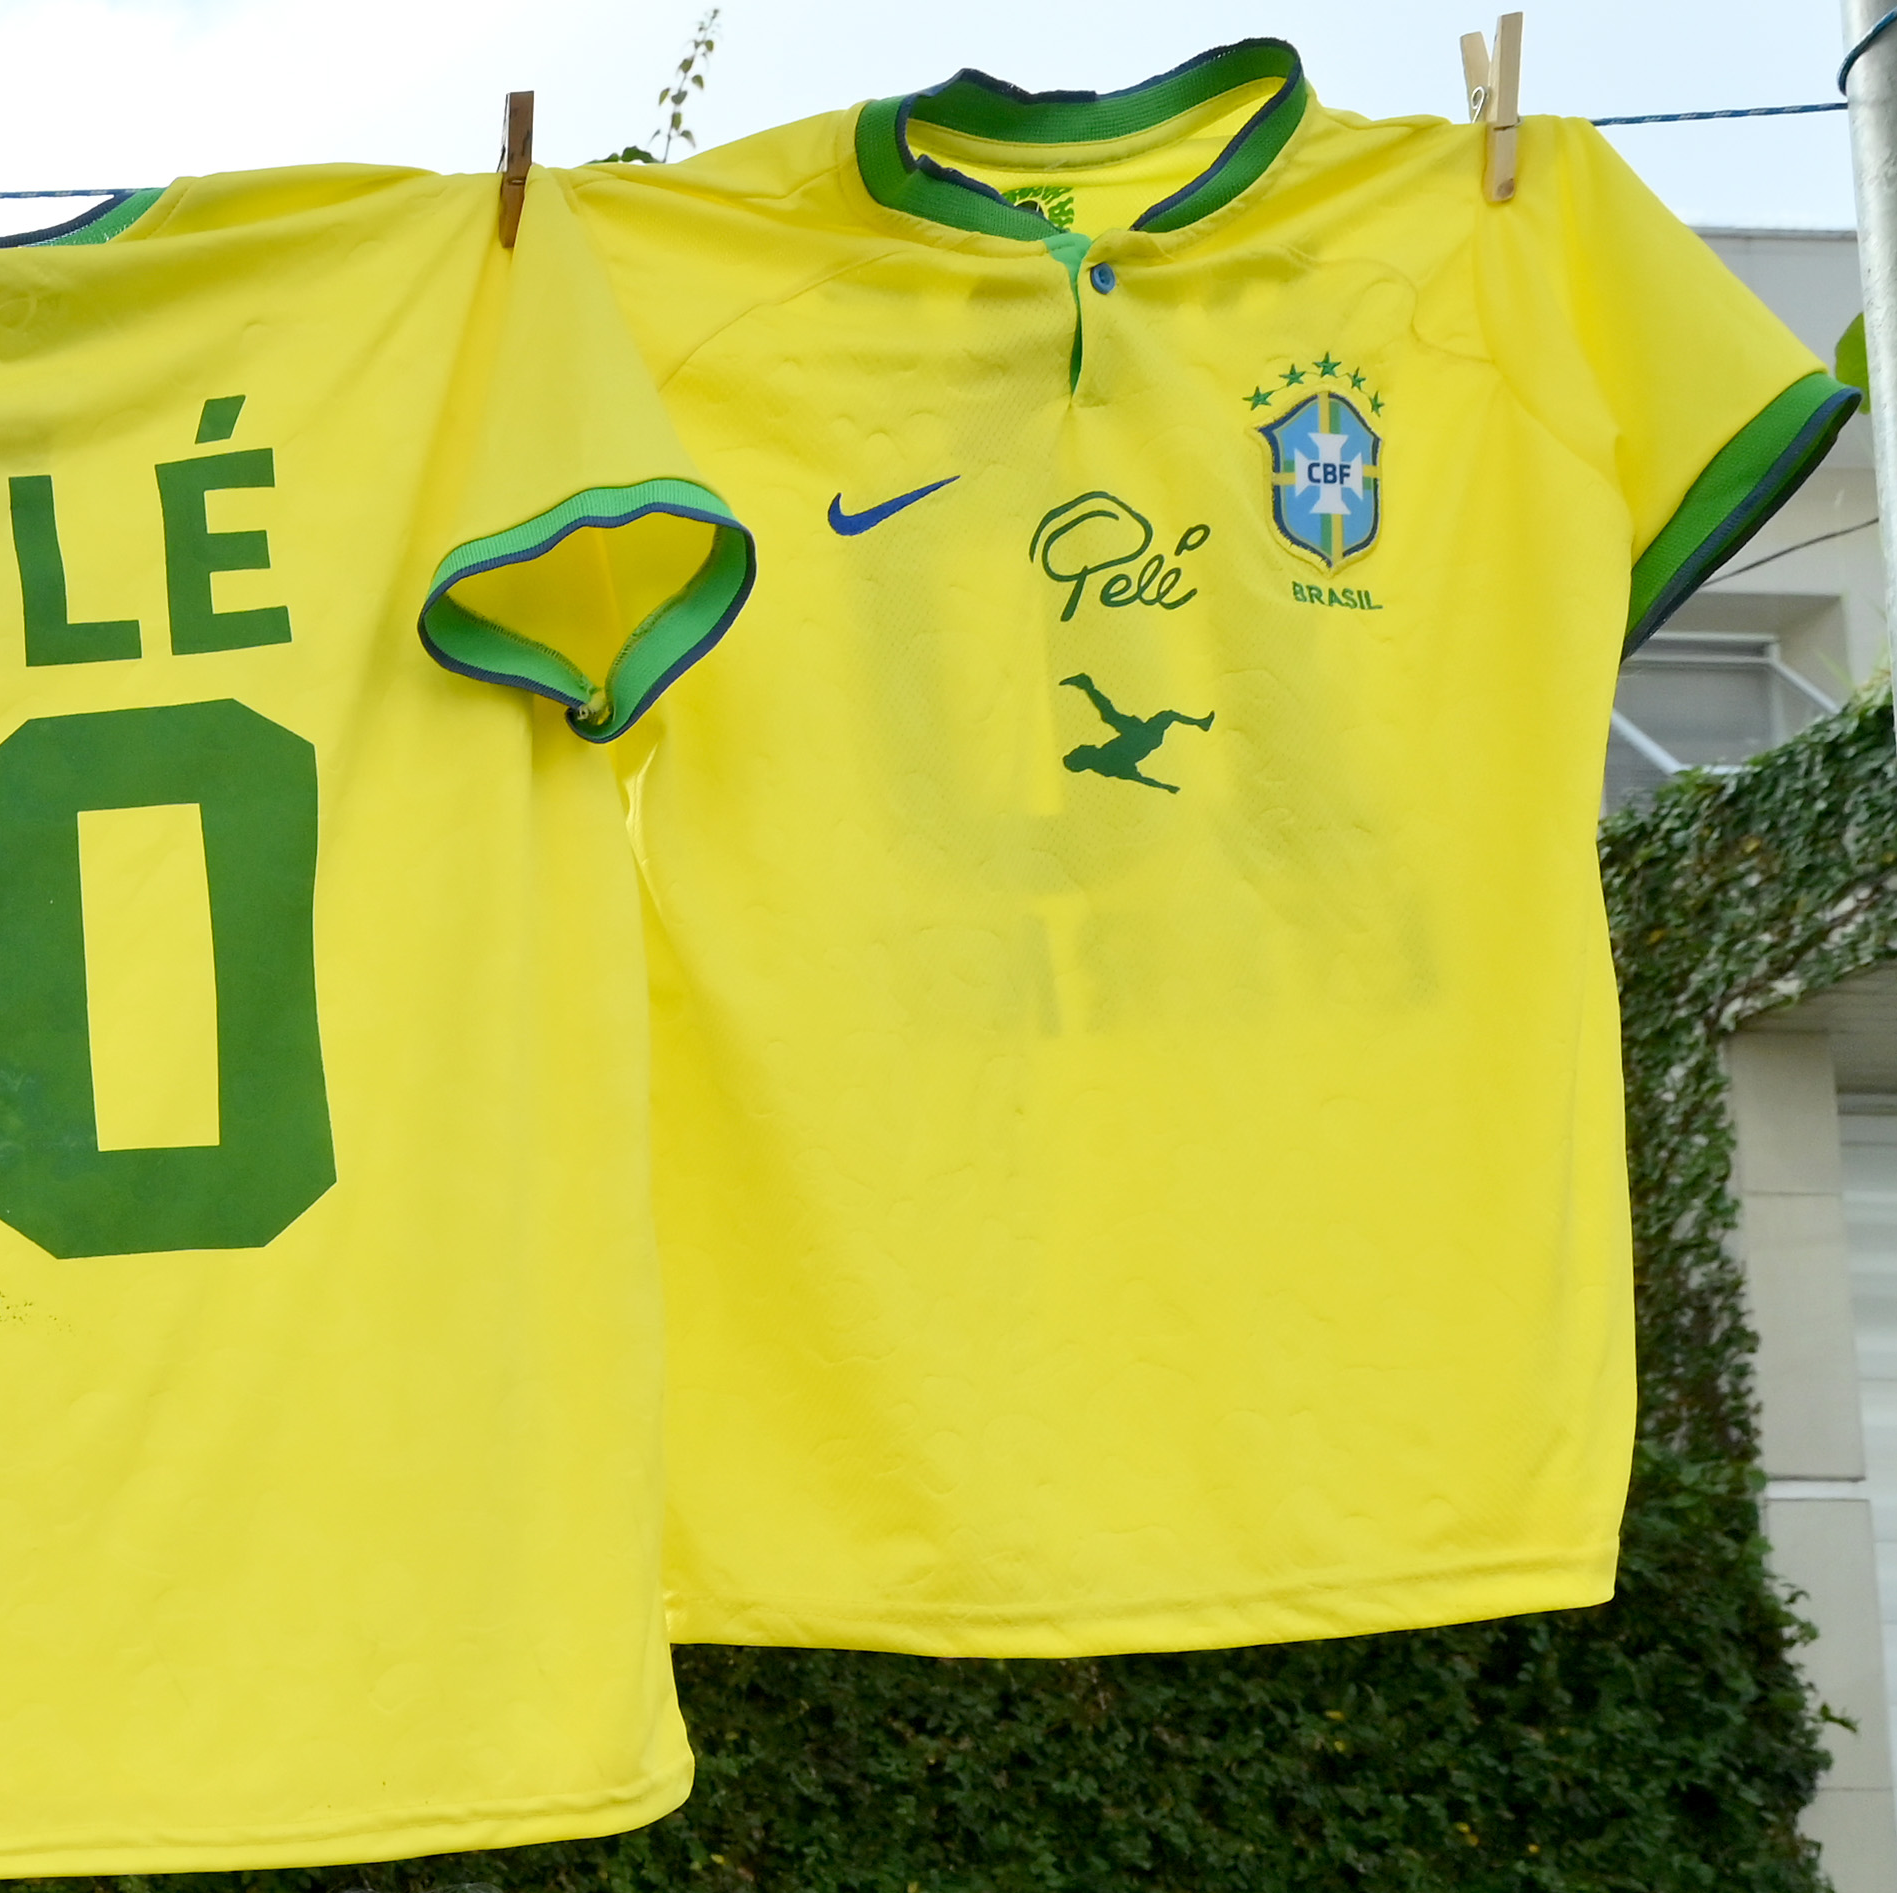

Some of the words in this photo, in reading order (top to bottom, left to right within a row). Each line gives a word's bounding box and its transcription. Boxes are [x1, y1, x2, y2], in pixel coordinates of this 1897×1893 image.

[1307, 462, 1352, 485] CBF
[1029, 490, 1211, 622] Pelé
[1292, 580, 1384, 610] BRASIL
